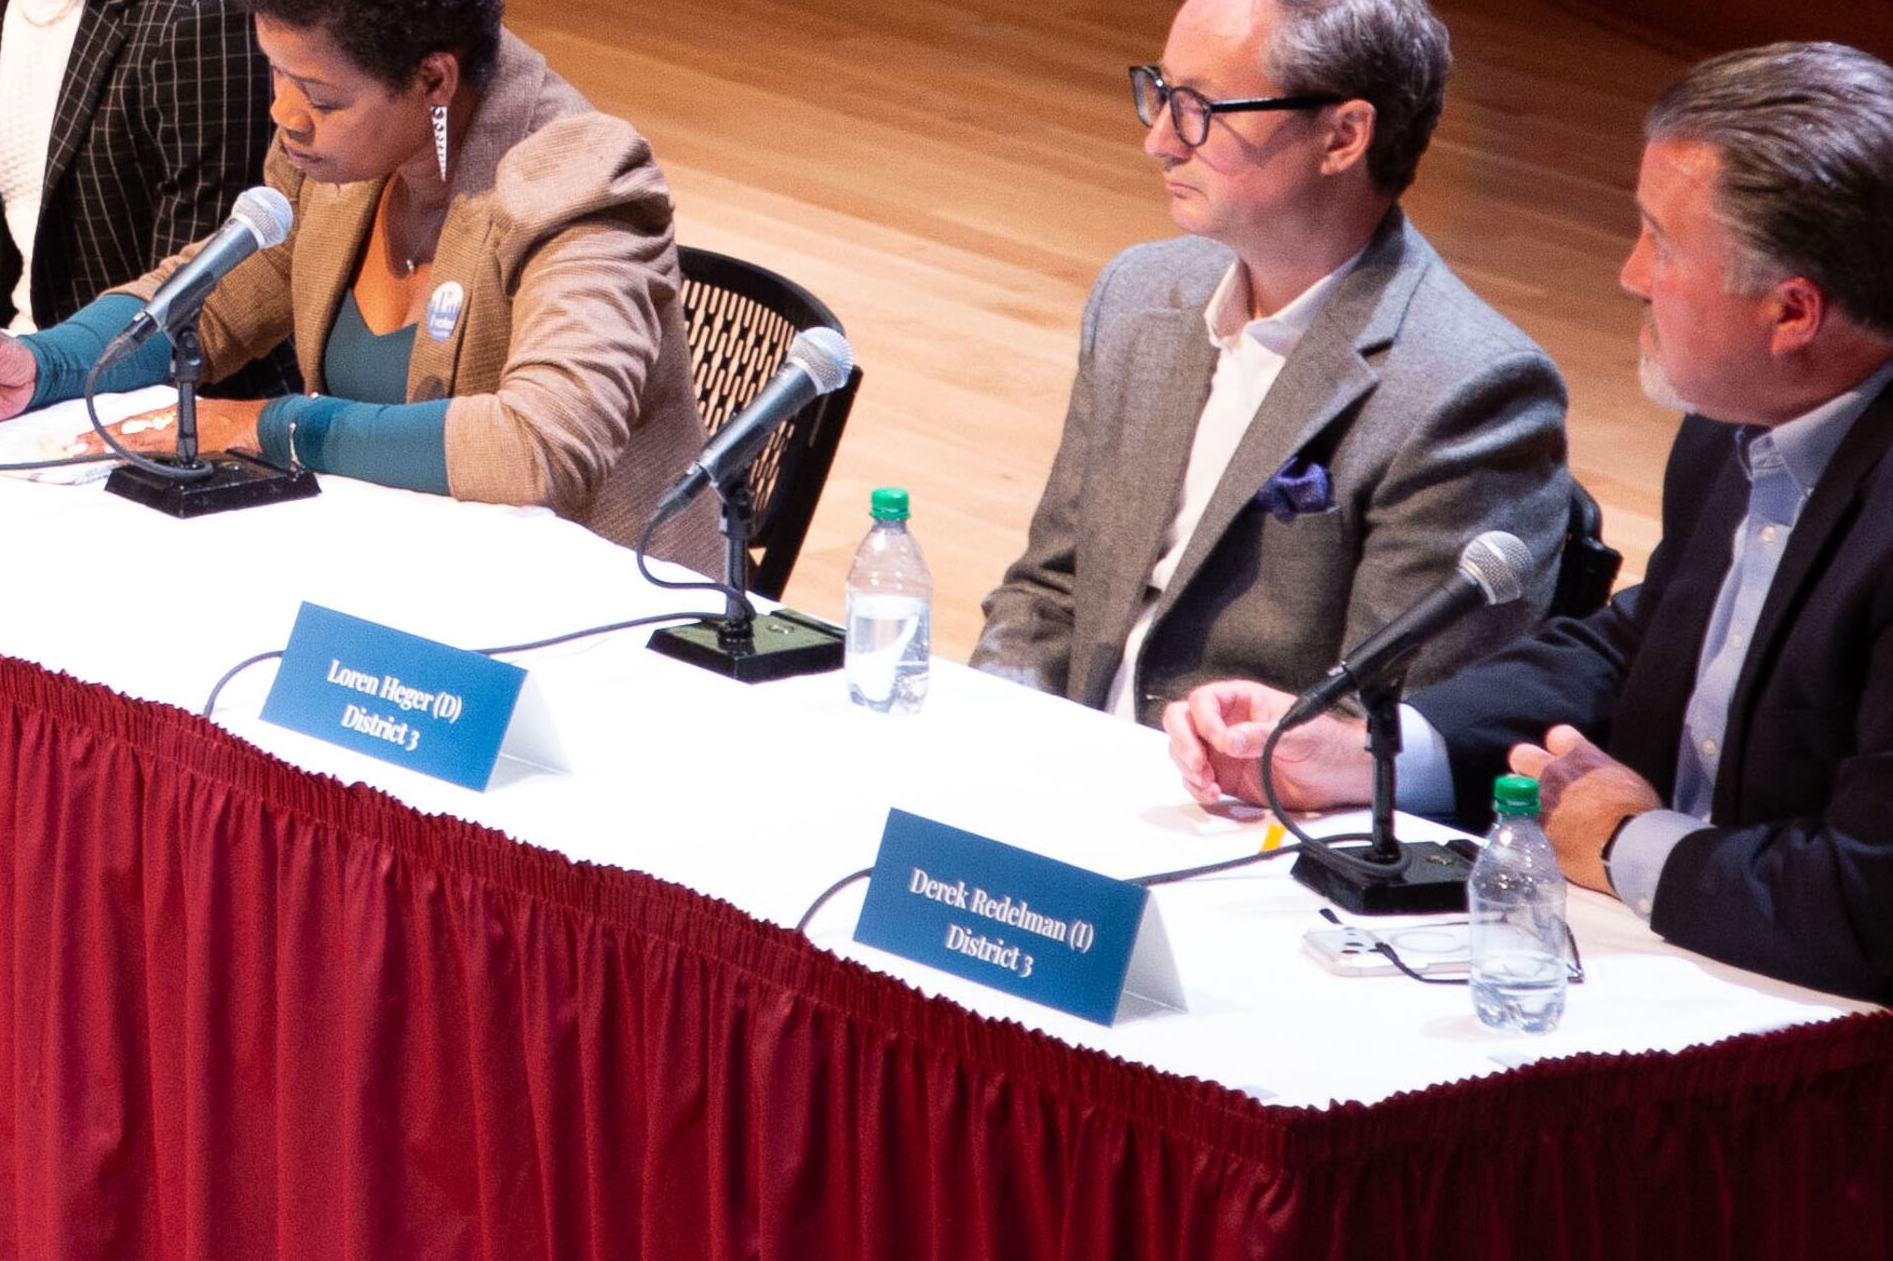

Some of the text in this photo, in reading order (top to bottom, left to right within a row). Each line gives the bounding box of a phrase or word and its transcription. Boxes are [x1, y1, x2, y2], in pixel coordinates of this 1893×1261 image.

[326, 659, 464, 723] Loren Heger (D)
[340, 703, 421, 752] District 3
[909, 867, 1095, 953] Derek Redelman (I)
[945, 923, 1034, 979] District 3
